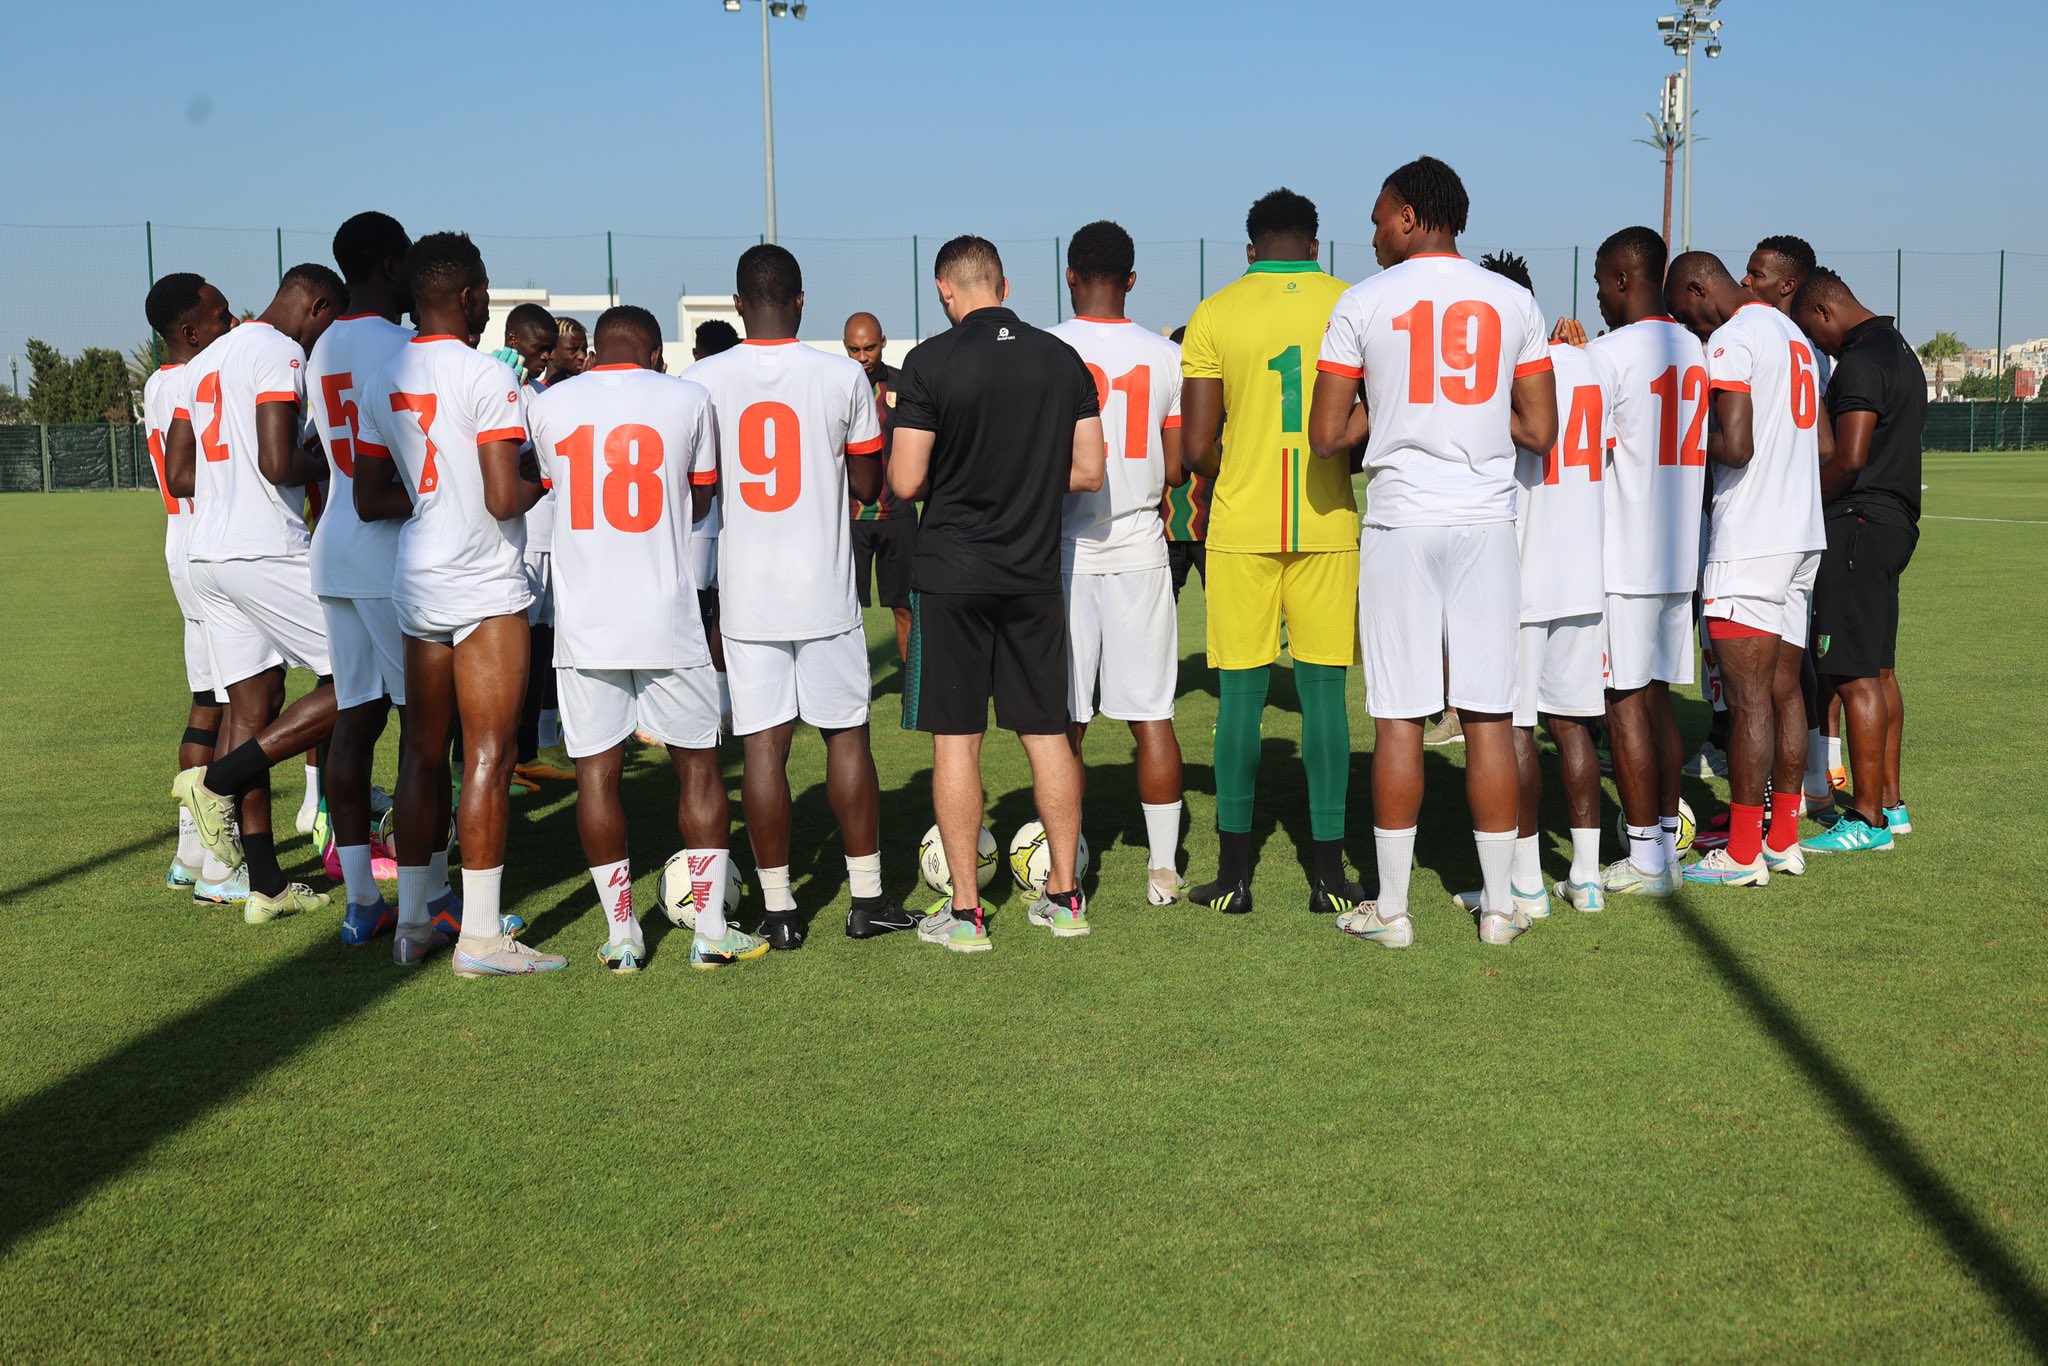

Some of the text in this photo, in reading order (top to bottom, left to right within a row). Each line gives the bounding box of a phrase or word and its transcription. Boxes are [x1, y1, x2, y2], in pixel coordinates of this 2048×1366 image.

[1268, 345, 1303, 433] 1
[1391, 299, 1502, 406] 19
[1789, 340, 1817, 430] 6
[195, 370, 230, 462] 2
[320, 371, 359, 479] 5
[388, 391, 439, 495] 7
[738, 400, 802, 513] 9
[1649, 365, 1710, 467] 12
[147, 428, 195, 515] 1
[554, 423, 665, 534] 18
